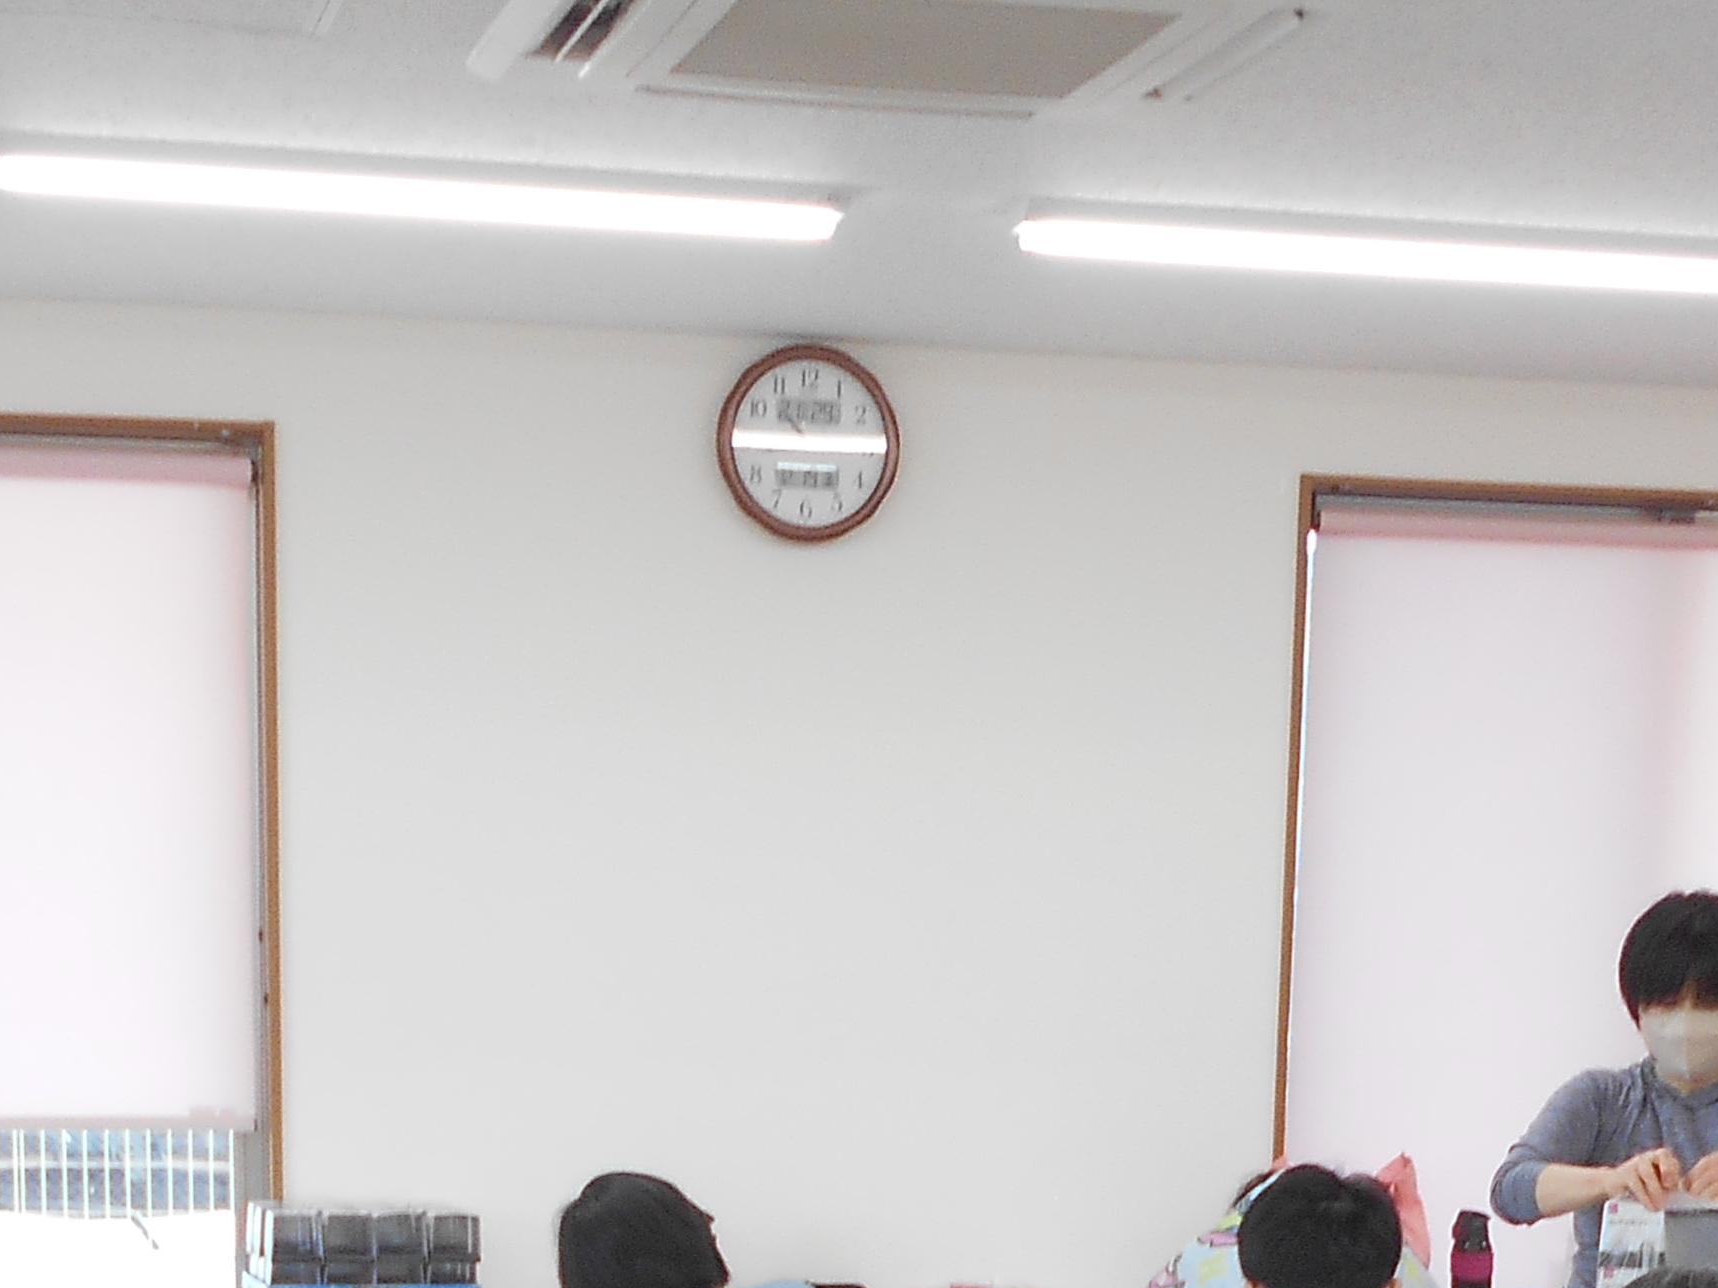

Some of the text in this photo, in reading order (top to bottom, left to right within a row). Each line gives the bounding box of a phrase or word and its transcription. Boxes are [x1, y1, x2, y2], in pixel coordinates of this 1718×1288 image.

[801, 368, 820, 388] 12
[749, 399, 767, 418] 10
[855, 405, 867, 425] 2
[771, 488, 783, 508] 7
[799, 500, 814, 519] 6
